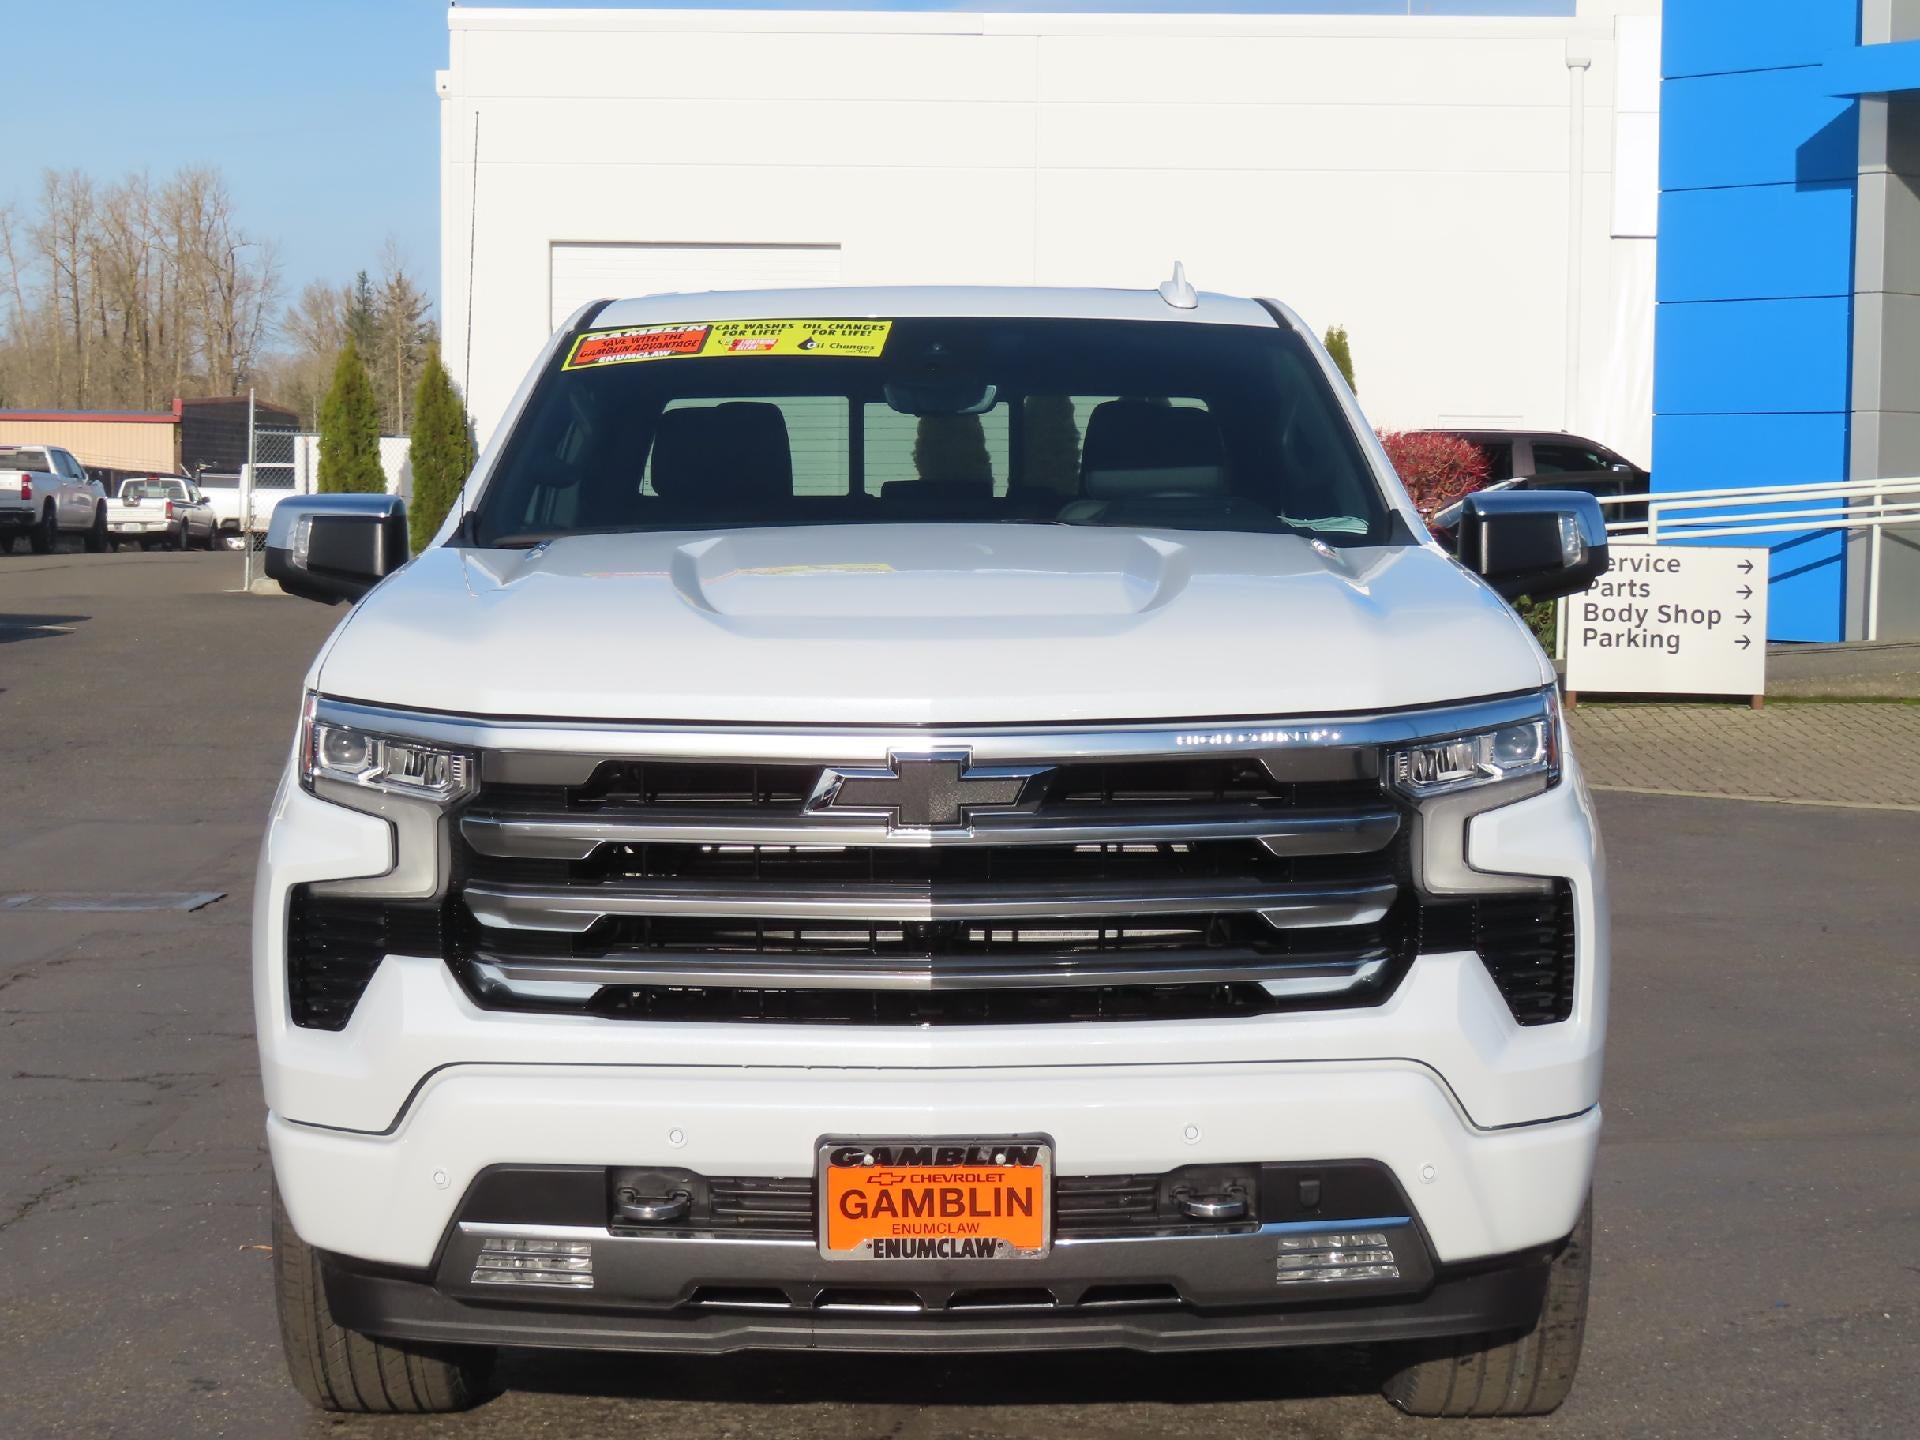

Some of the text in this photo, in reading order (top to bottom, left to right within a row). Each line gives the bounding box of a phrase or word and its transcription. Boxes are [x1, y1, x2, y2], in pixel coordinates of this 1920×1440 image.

[715, 323, 740, 331] CAR
[828, 323, 886, 331] CHANGES
[602, 333, 685, 348] SAVE WITH THE
[632, 339, 700, 352] ADVANTAGE
[1607, 553, 1681, 573] ervice
[1583, 602, 1722, 630] Body Shop
[1583, 628, 1680, 654] Parking
[830, 1147, 1040, 1168] GAMBLIN
[910, 1173, 1006, 1184] CHEVROLET
[839, 1187, 1033, 1219] GAMBLIN
[892, 1222, 980, 1235] ENUMCLAW
[873, 1238, 997, 1259] ENUMCLAW
